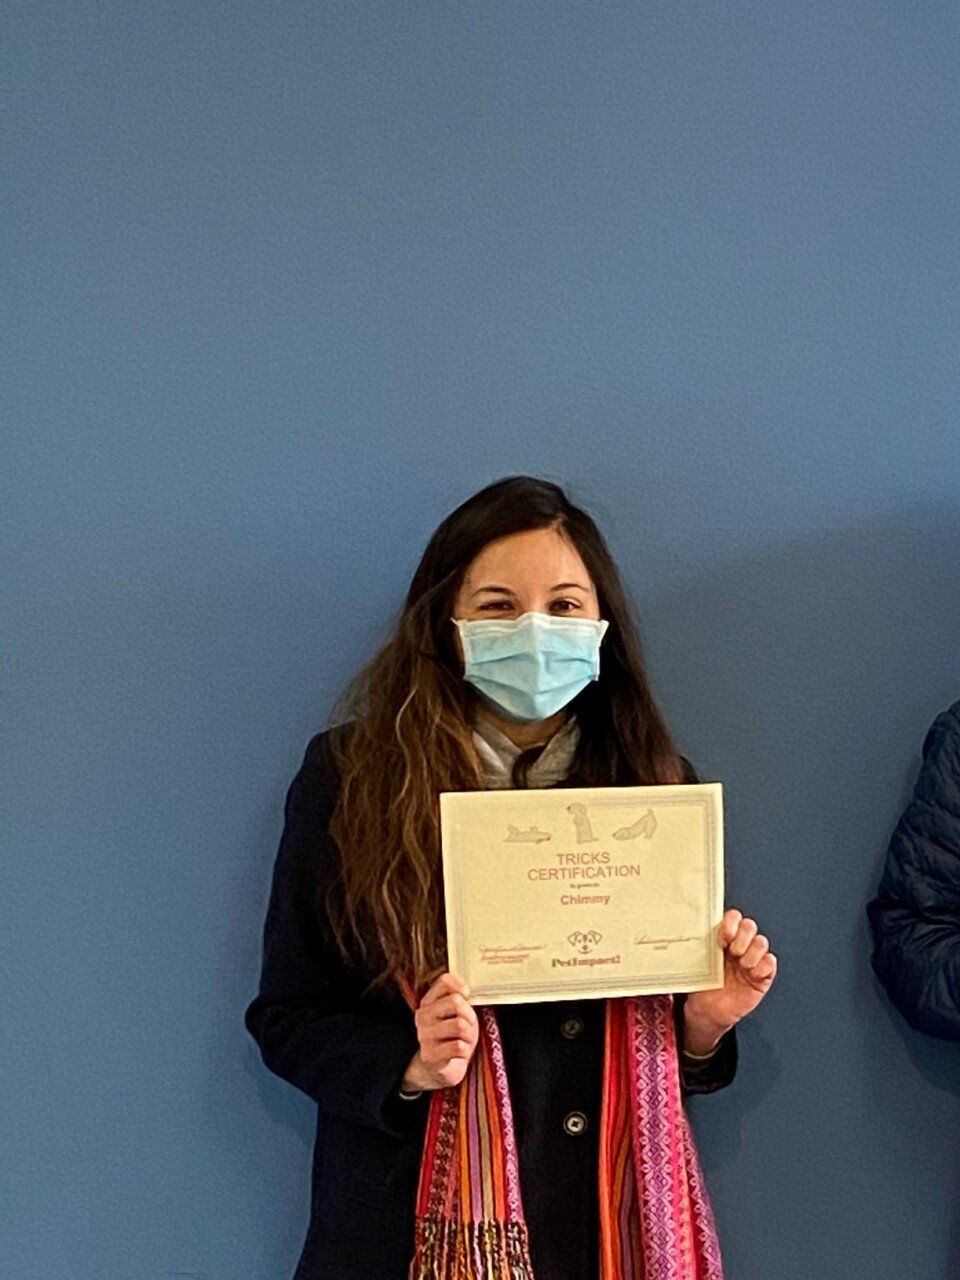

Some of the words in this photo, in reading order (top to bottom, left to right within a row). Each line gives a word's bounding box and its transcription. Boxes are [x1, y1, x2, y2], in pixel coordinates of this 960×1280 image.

[556, 852, 611, 865] TRICKS
[527, 864, 641, 881] CERTIFICATION
[560, 894, 611, 906] Chimmy
